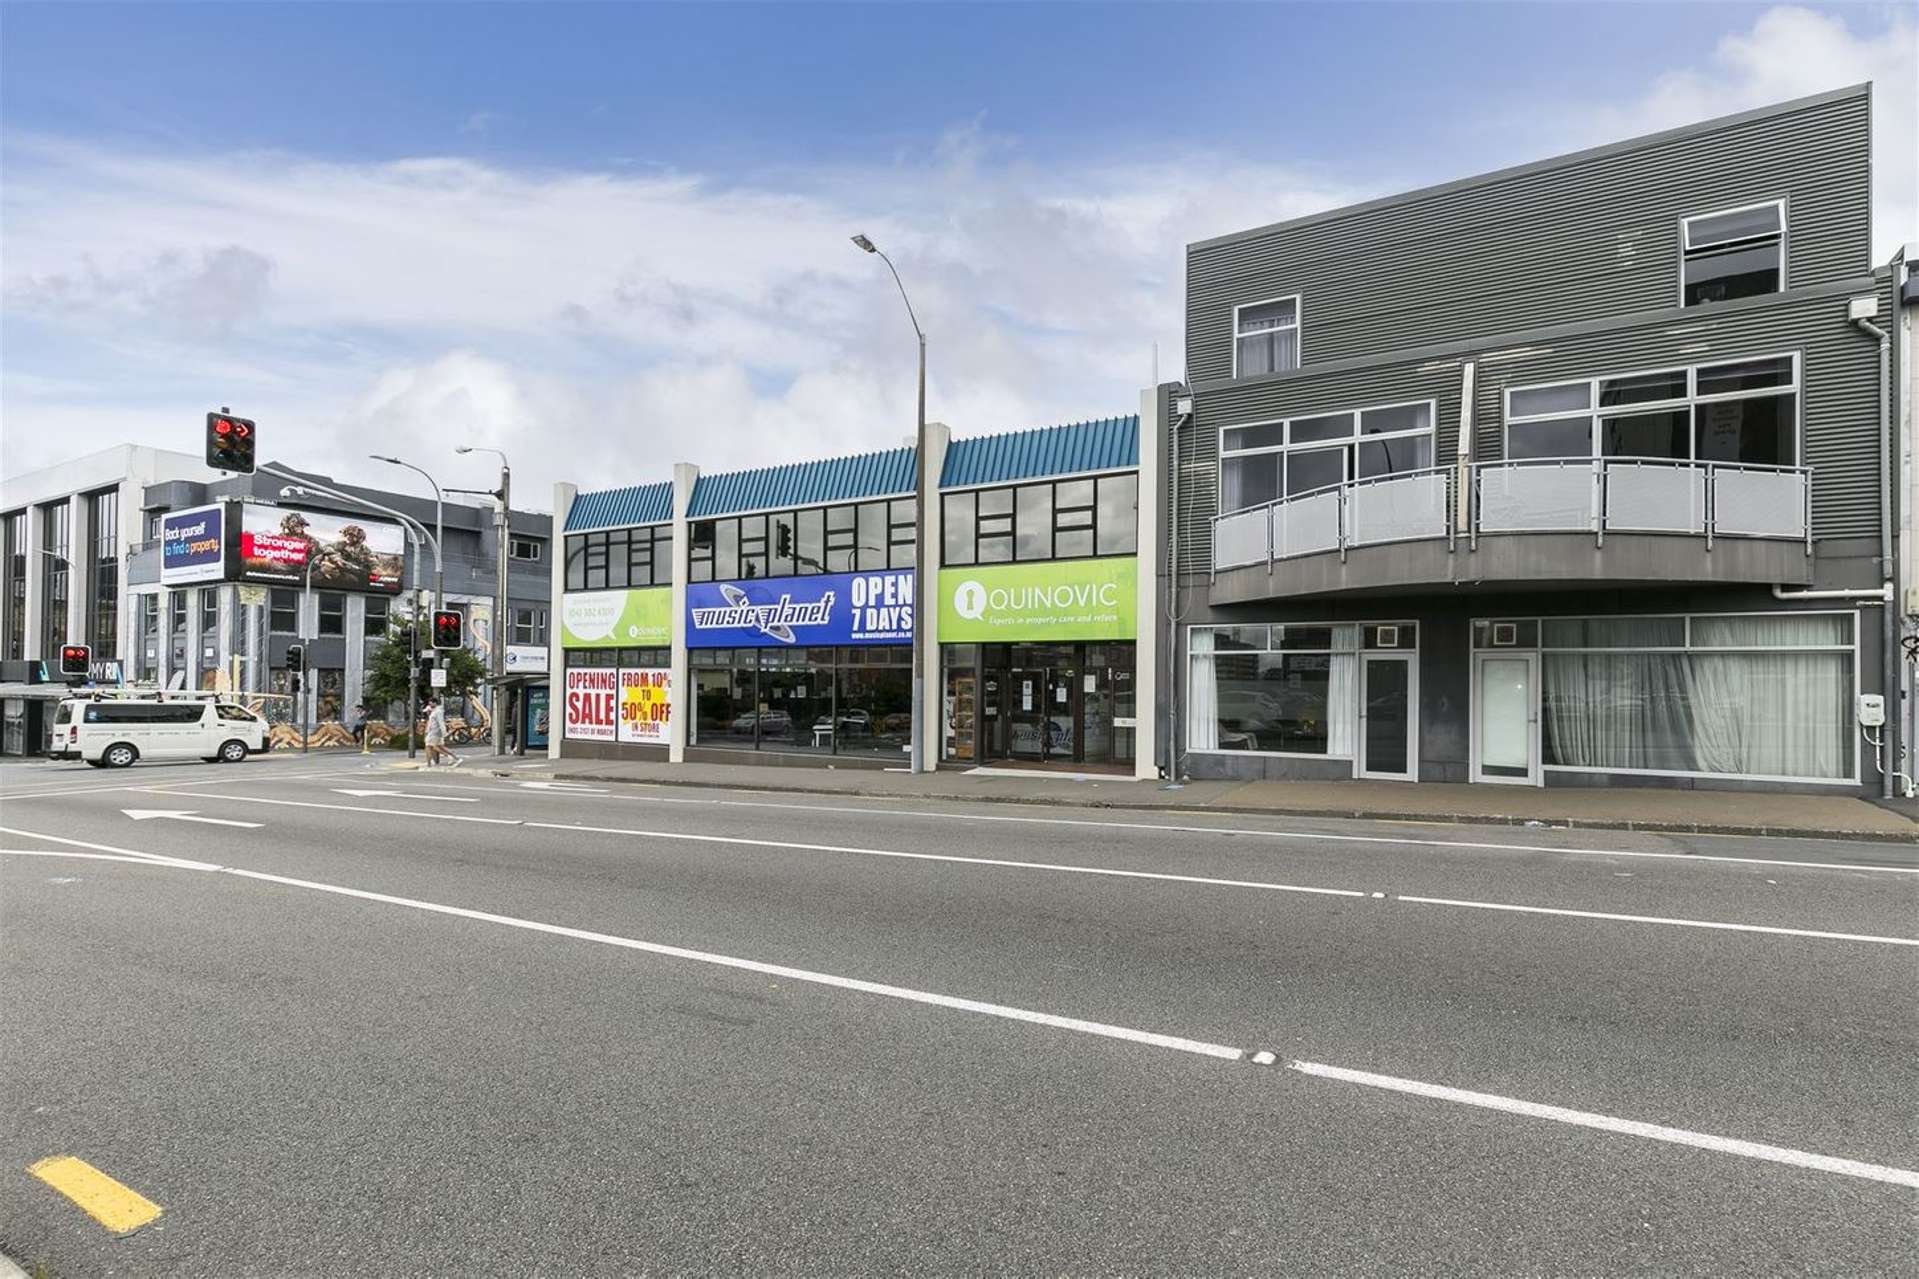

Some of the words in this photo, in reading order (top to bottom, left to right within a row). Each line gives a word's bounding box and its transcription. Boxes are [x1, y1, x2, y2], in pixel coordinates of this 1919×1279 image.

[165, 527, 179, 540] Back
[180, 521, 206, 540] yourself
[253, 534, 307, 550] Stronger
[253, 545, 306, 561] together
[851, 574, 913, 608] OPEN
[989, 583, 1118, 611] QUINOVIC
[692, 598, 756, 629] music
[758, 590, 836, 633] planet
[851, 608, 861, 632] 7
[866, 606, 913, 631] DAYS
[568, 672, 615, 689] OPENING
[621, 672, 649, 688] FROM
[641, 689, 652, 701] TO
[568, 691, 615, 726] SALE
[621, 702, 648, 721] 50%
[651, 703, 672, 722] OFF
[640, 722, 660, 733] STORE
